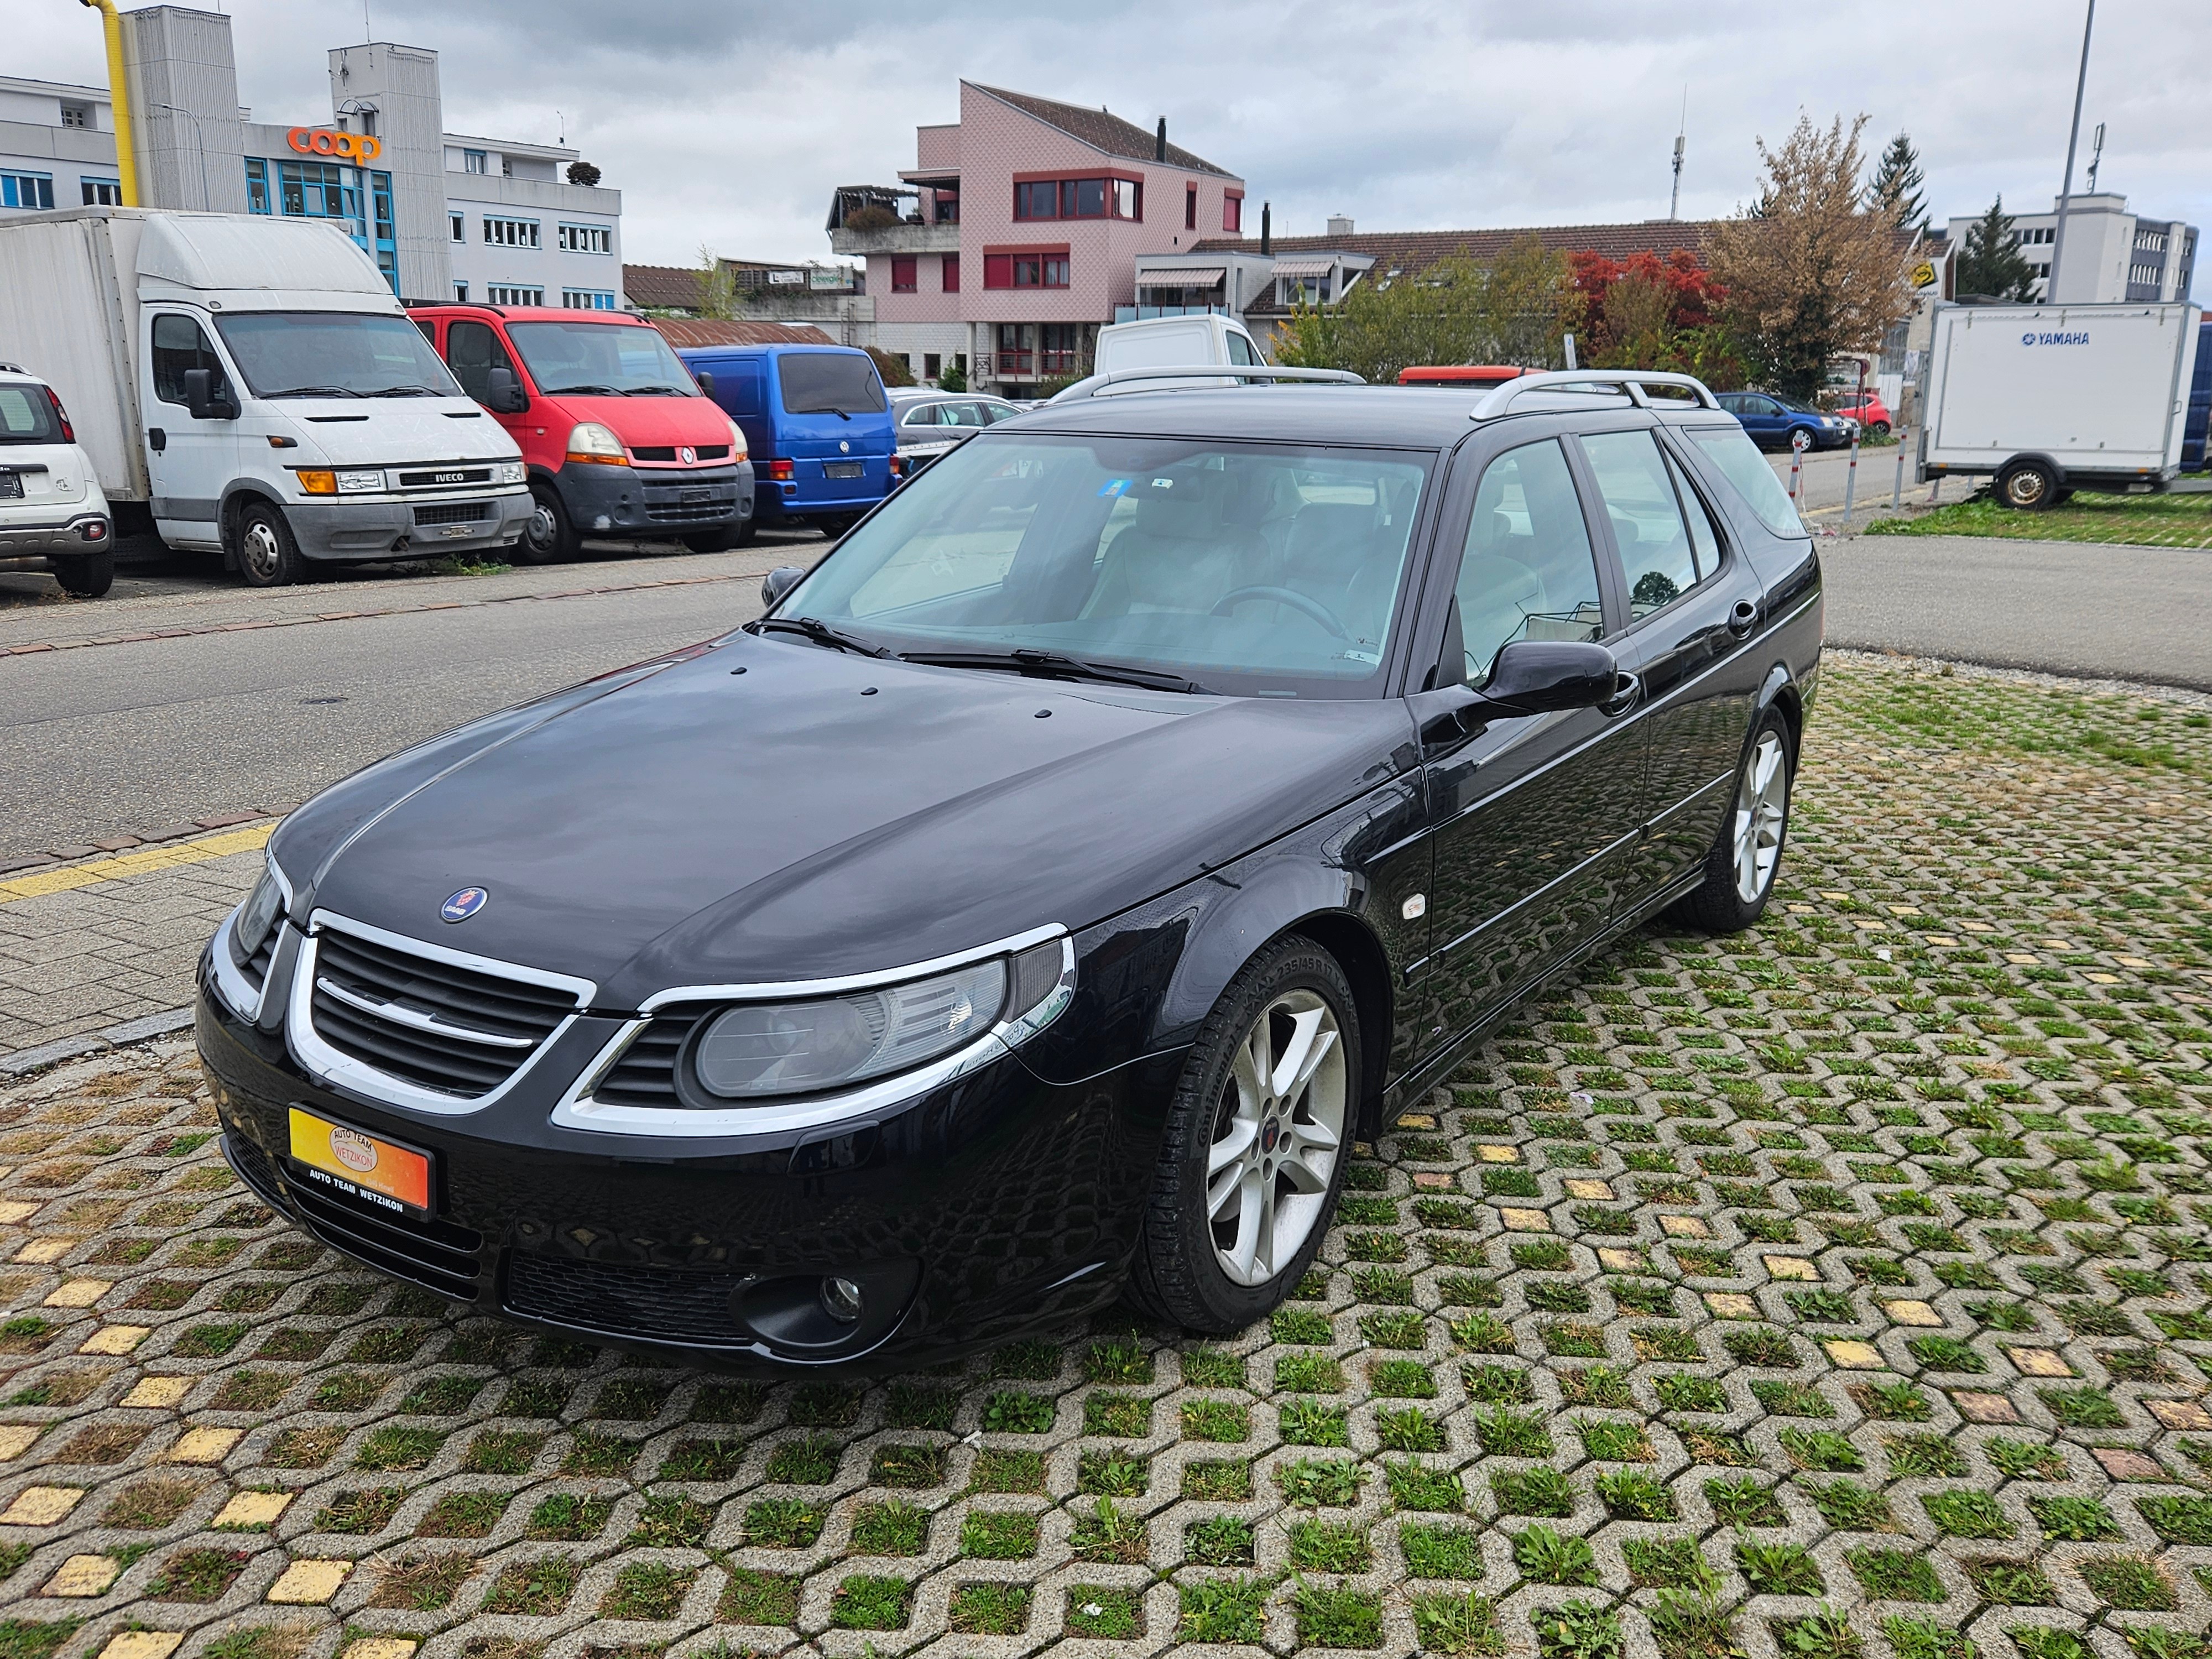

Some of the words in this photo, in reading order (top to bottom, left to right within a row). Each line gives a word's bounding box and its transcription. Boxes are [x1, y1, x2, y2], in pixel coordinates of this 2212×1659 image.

[286, 127, 381, 166] coop
[2039, 332, 2089, 345] YAMAHA
[435, 473, 464, 482] IVECO
[445, 905, 466, 915] SAAB
[1277, 957, 1314, 979] 235/45
[1197, 1034, 1237, 1148] Continental
[334, 1129, 351, 1139] AUTO
[353, 1132, 372, 1151] TEAM
[335, 1145, 373, 1168] WETZIKON
[310, 1169, 331, 1184] AUTO
[333, 1178, 356, 1194] TEAM
[359, 1188, 403, 1213] WETZIKON
